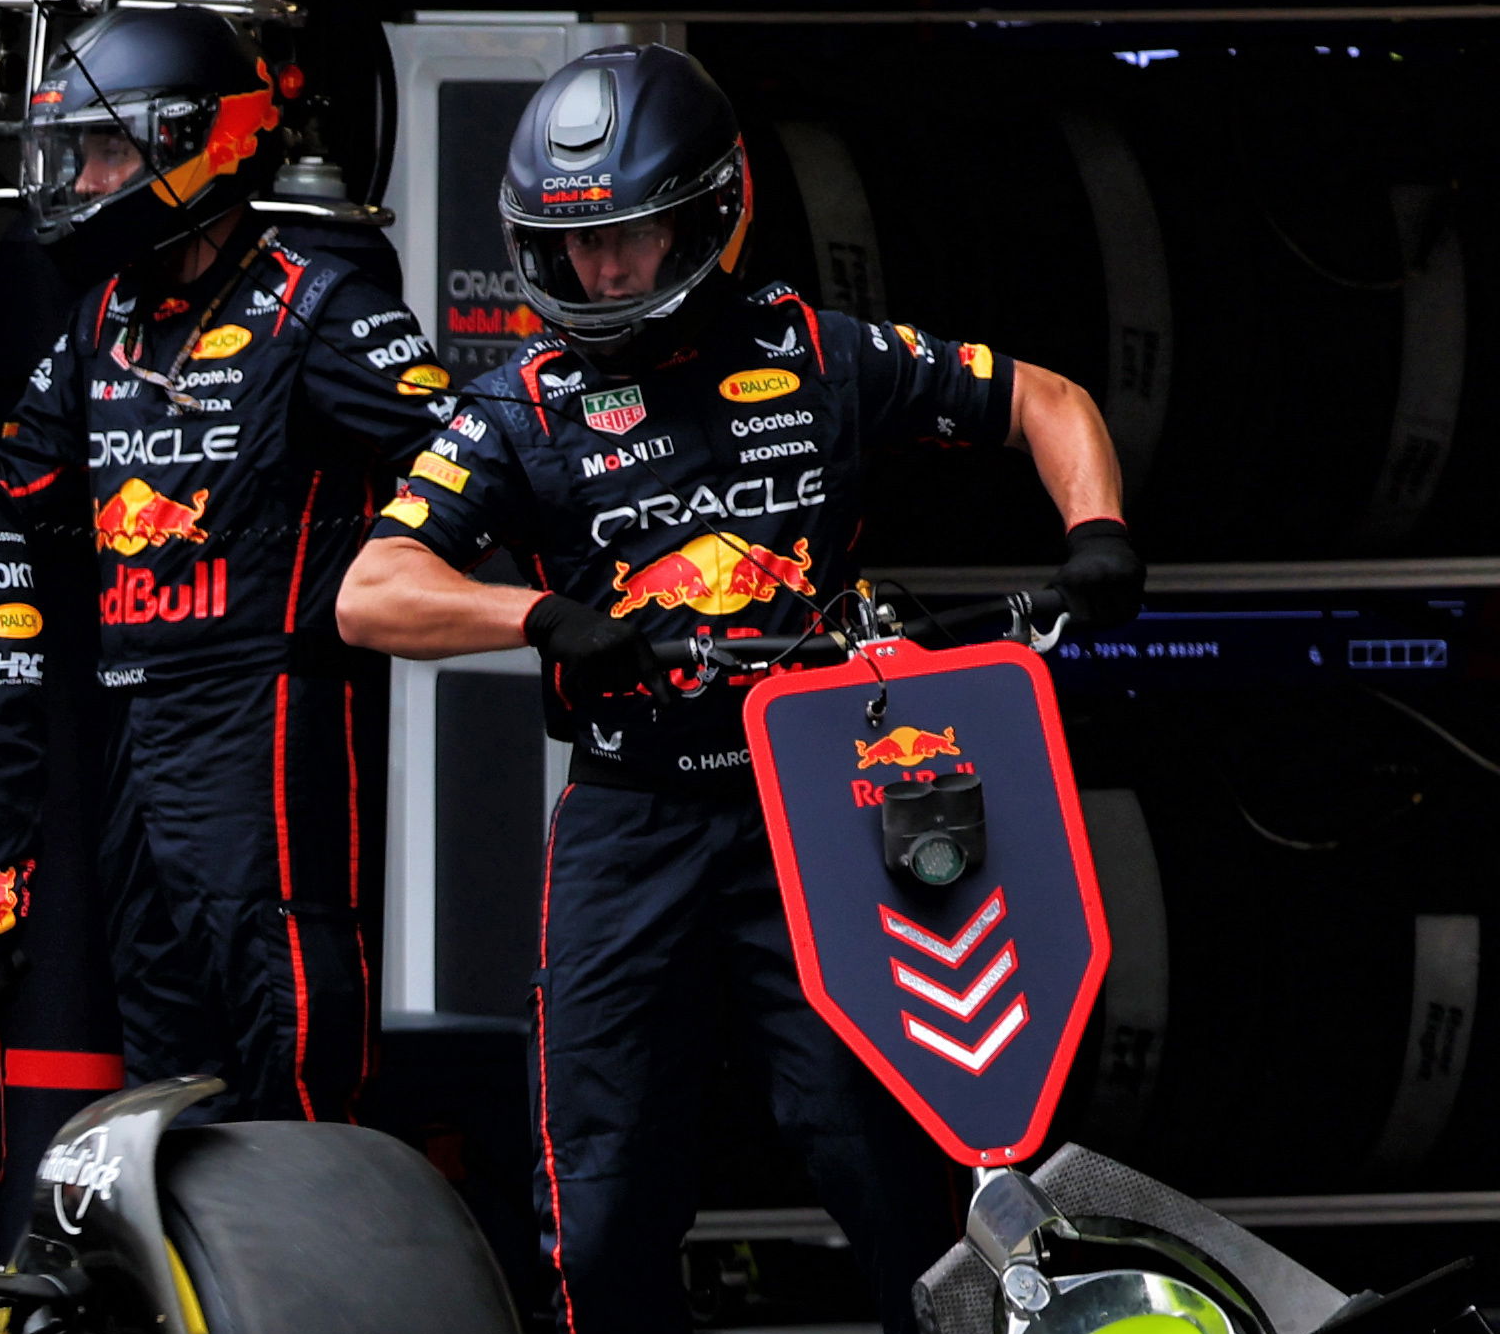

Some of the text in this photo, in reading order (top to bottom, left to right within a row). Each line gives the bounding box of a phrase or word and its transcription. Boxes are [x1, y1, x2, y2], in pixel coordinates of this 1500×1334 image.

[542, 173, 612, 190] ORACLE
[544, 203, 614, 216] RACING
[187, 367, 244, 386] Gate.io
[739, 376, 791, 395] RAUCH
[587, 391, 639, 411] TAG
[449, 414, 488, 444] obil
[590, 406, 646, 433] HEUER
[748, 410, 814, 434] Gate.io
[88, 425, 241, 468] ORACLE
[739, 440, 819, 465] HONDA
[582, 442, 649, 478] Mobil
[591, 466, 827, 548] ORACLE
[123, 557, 227, 625] Bull
[677, 748, 751, 771] O. HARC
